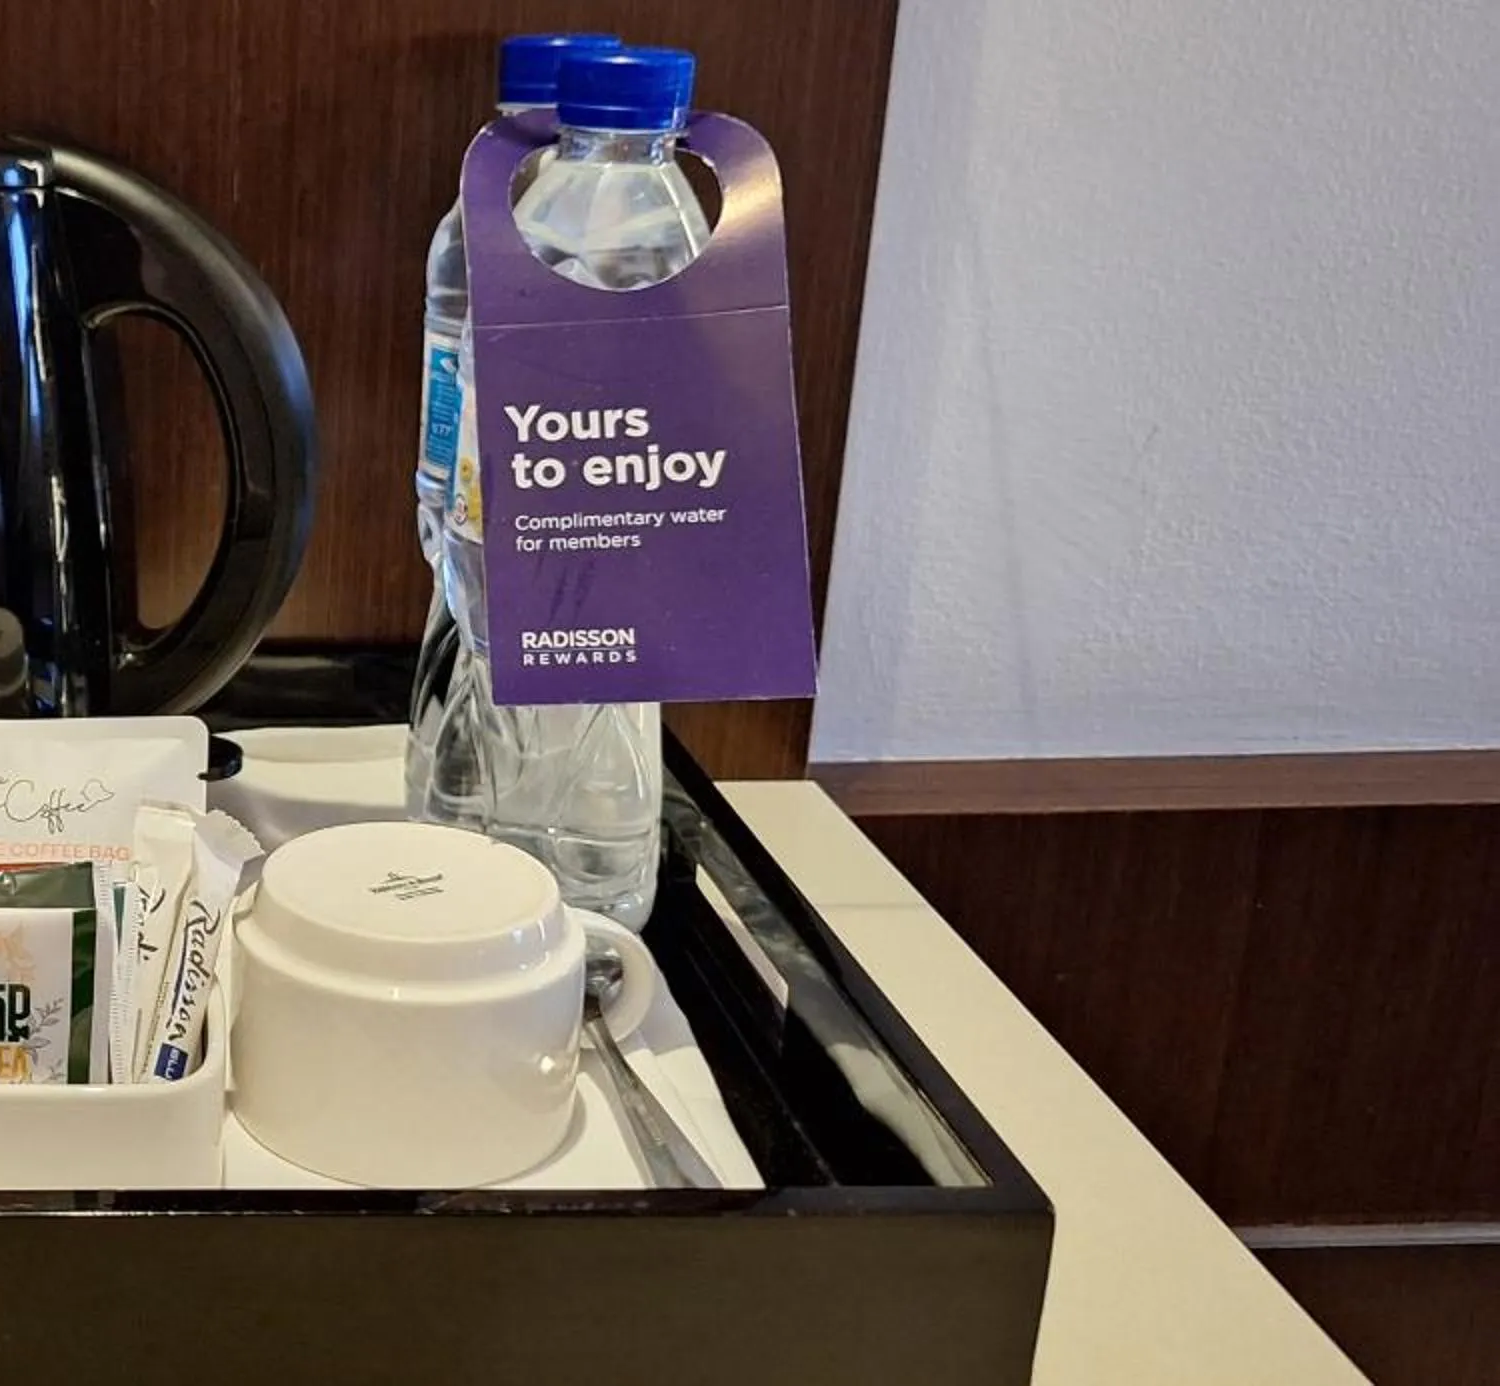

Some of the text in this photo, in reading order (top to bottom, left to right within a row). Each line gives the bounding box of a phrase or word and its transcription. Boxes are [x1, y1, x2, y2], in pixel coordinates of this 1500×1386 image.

[504, 405, 649, 443] Yours
[511, 444, 726, 491] to enjoy
[515, 507, 727, 532] Complimentary water
[516, 533, 641, 551] for members
[521, 627, 636, 649] RADISSON
[523, 649, 637, 666] REWARDS
[7, 843, 85, 861] COFFEE
[88, 845, 131, 861] BAG
[168, 900, 220, 1041] Radisson
